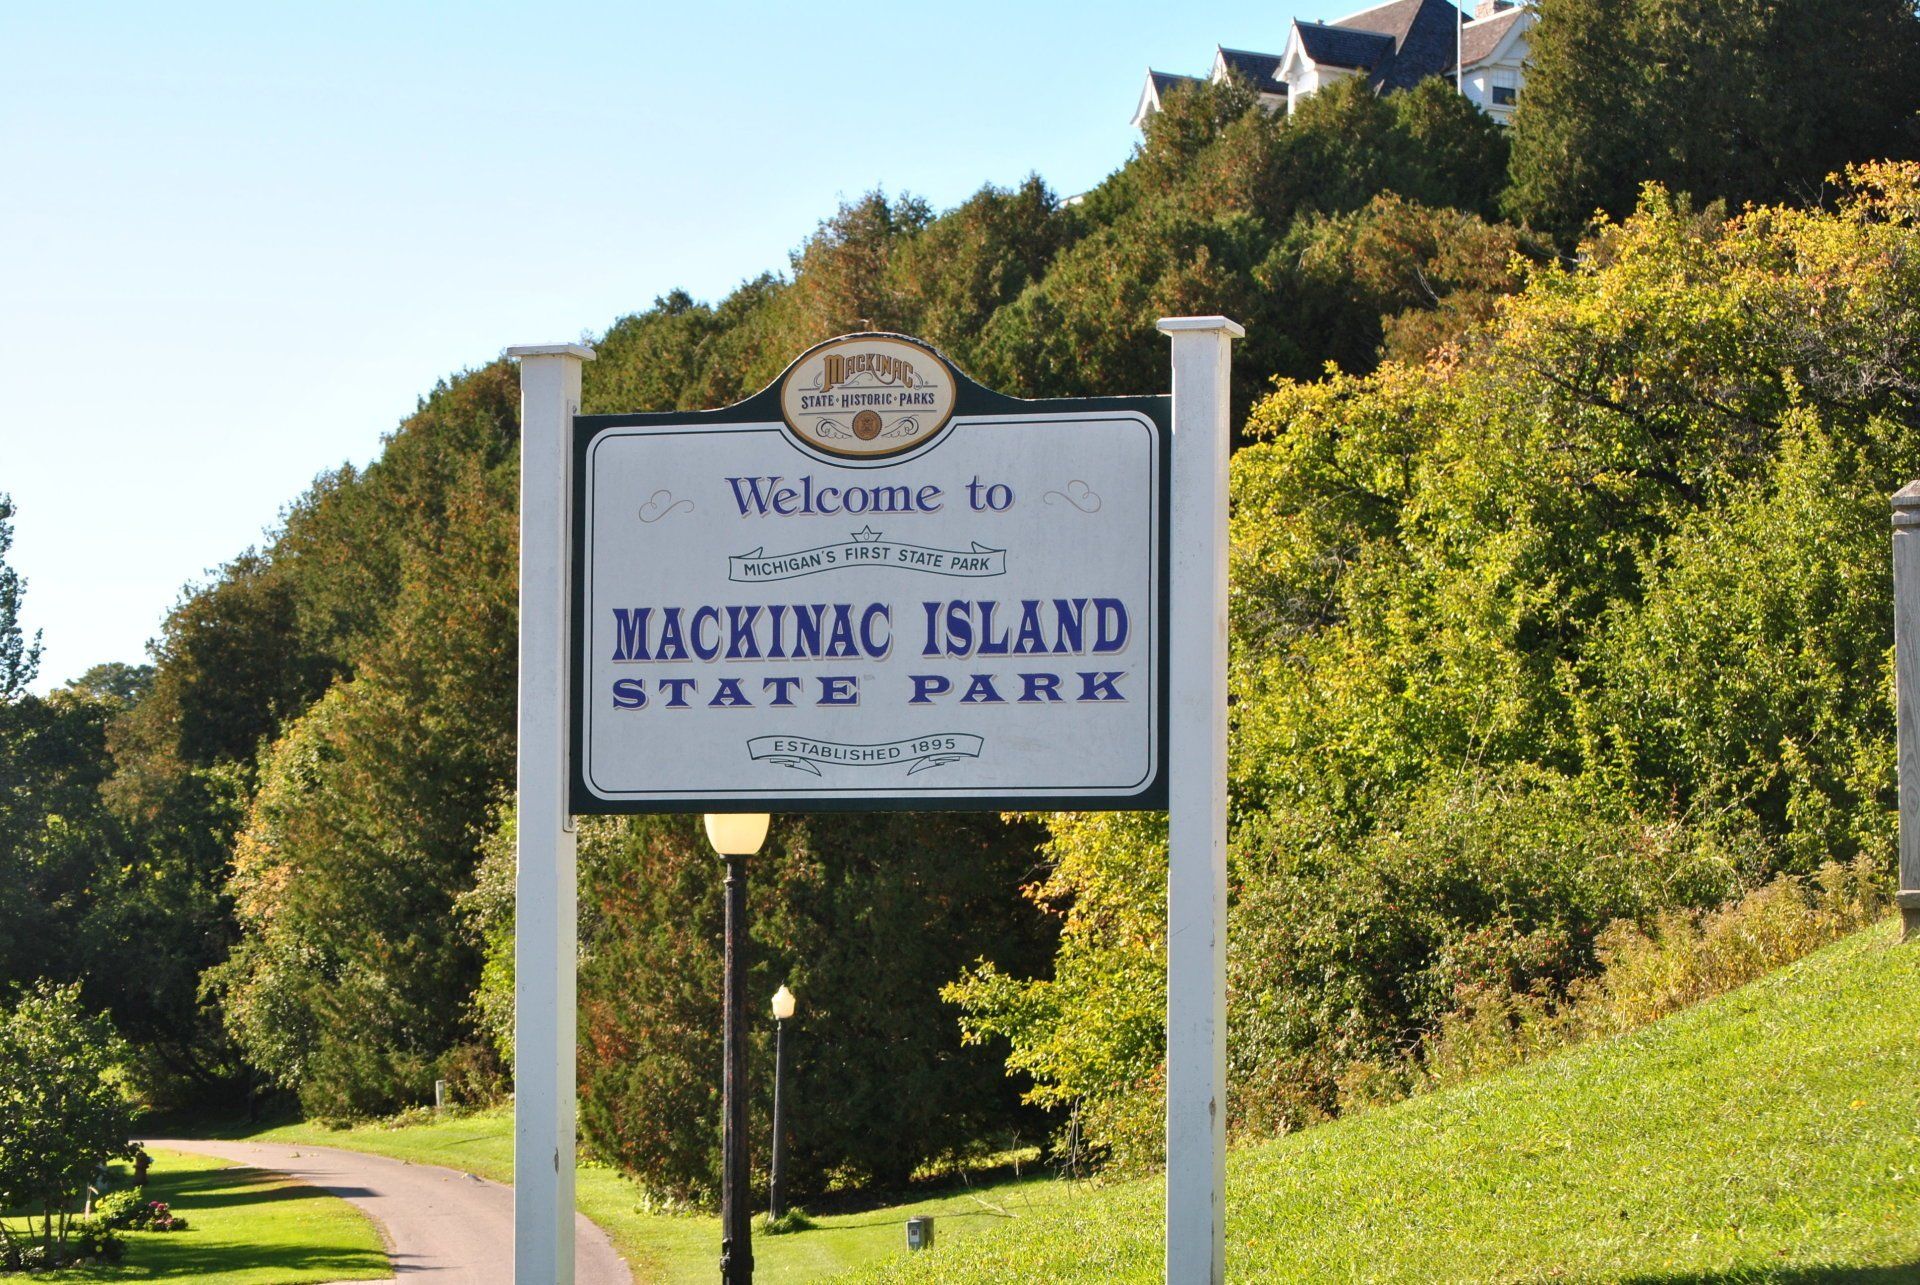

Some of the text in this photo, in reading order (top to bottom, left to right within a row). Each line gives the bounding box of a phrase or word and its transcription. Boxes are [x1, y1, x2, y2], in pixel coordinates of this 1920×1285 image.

[820, 353, 913, 393] MACKINAC
[801, 392, 935, 409] STATE HISTORIC PARKS
[725, 475, 1014, 517] Welcome to
[743, 547, 990, 576] MICHIGAN'S FIRST STATE PARK
[612, 597, 1131, 662] MACKINAC ISLAND
[612, 671, 1130, 709] STATE PARK
[774, 738, 956, 761] ESTABLISHED 1895
